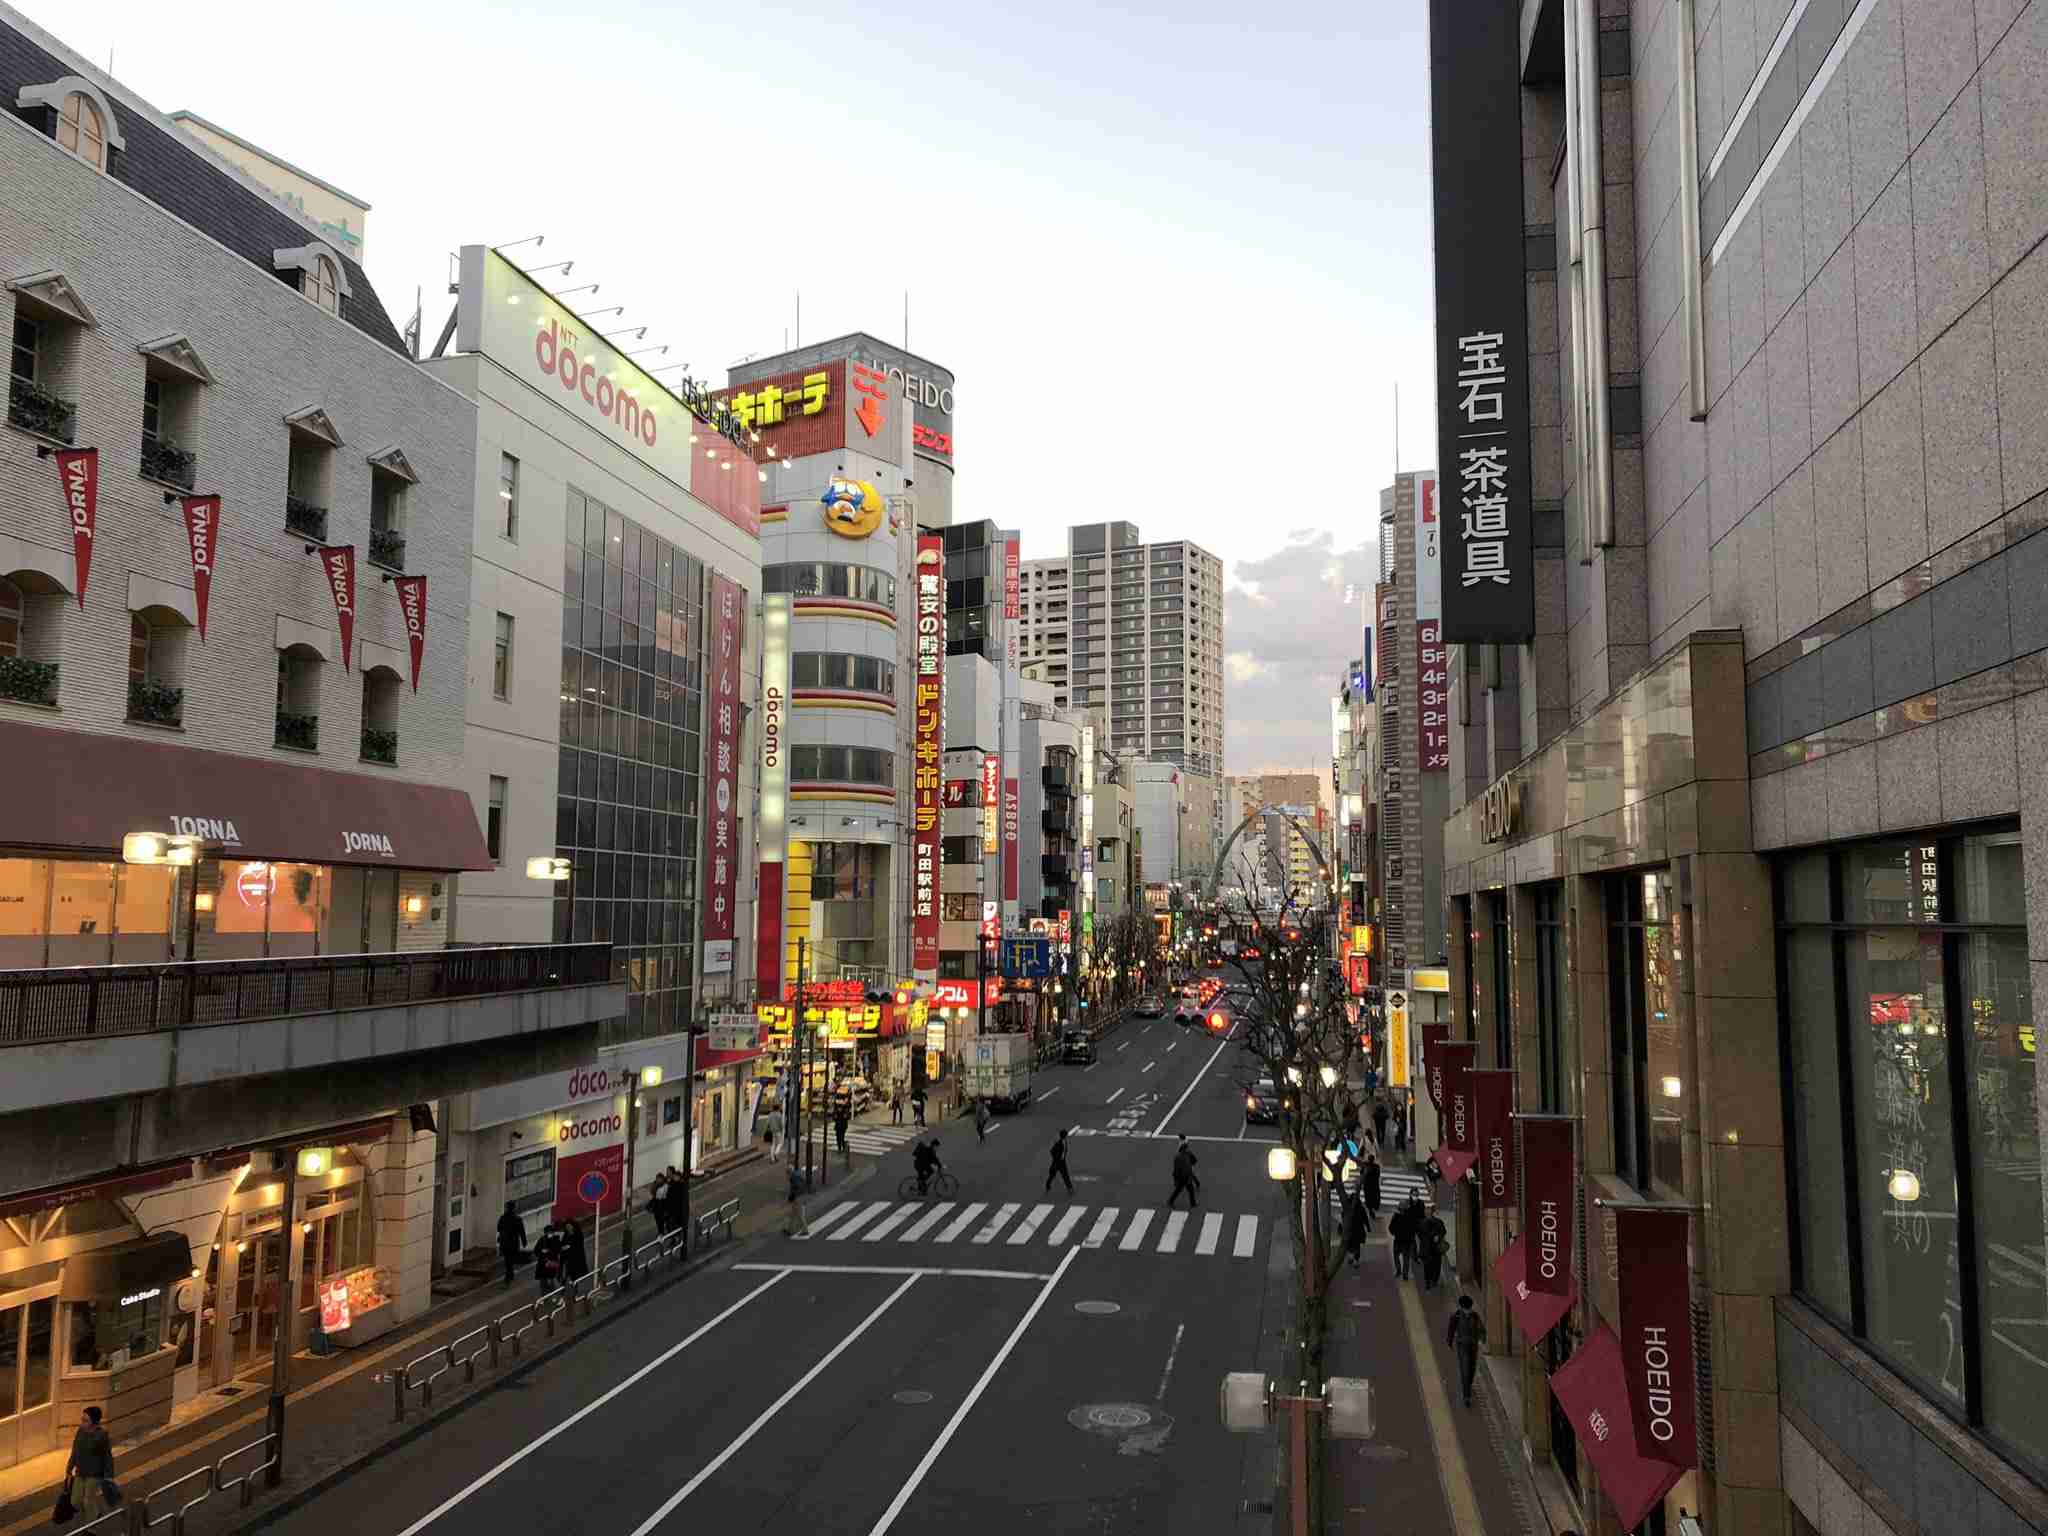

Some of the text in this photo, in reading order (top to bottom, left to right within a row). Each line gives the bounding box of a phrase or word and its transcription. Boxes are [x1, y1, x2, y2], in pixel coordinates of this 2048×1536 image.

[536, 318, 657, 447] docomo
[1458, 331, 1511, 587] 宝石 茶道具
[73, 459, 88, 537] JORNA
[193, 503, 211, 575] JORNA
[331, 553, 351, 616] JORNA
[403, 582, 423, 640] JORNA
[1421, 627, 1441, 643] 6
[1421, 650, 1445, 664] 5F
[1421, 671, 1445, 685] 4F
[1422, 691, 1447, 706] 3F
[1423, 712, 1447, 726] 2F
[767, 687, 783, 768] docomo
[1425, 732, 1448, 747] 1F
[170, 815, 239, 842] JORNA
[342, 831, 393, 855] JORNA
[934, 986, 968, 1001] アコム
[1454, 1095, 1465, 1142] HOEIDO
[1490, 1137, 1505, 1196] HOEIDO
[1541, 1201, 1557, 1279] HOEIDO
[1644, 1327, 1674, 1442] HOEIDO
